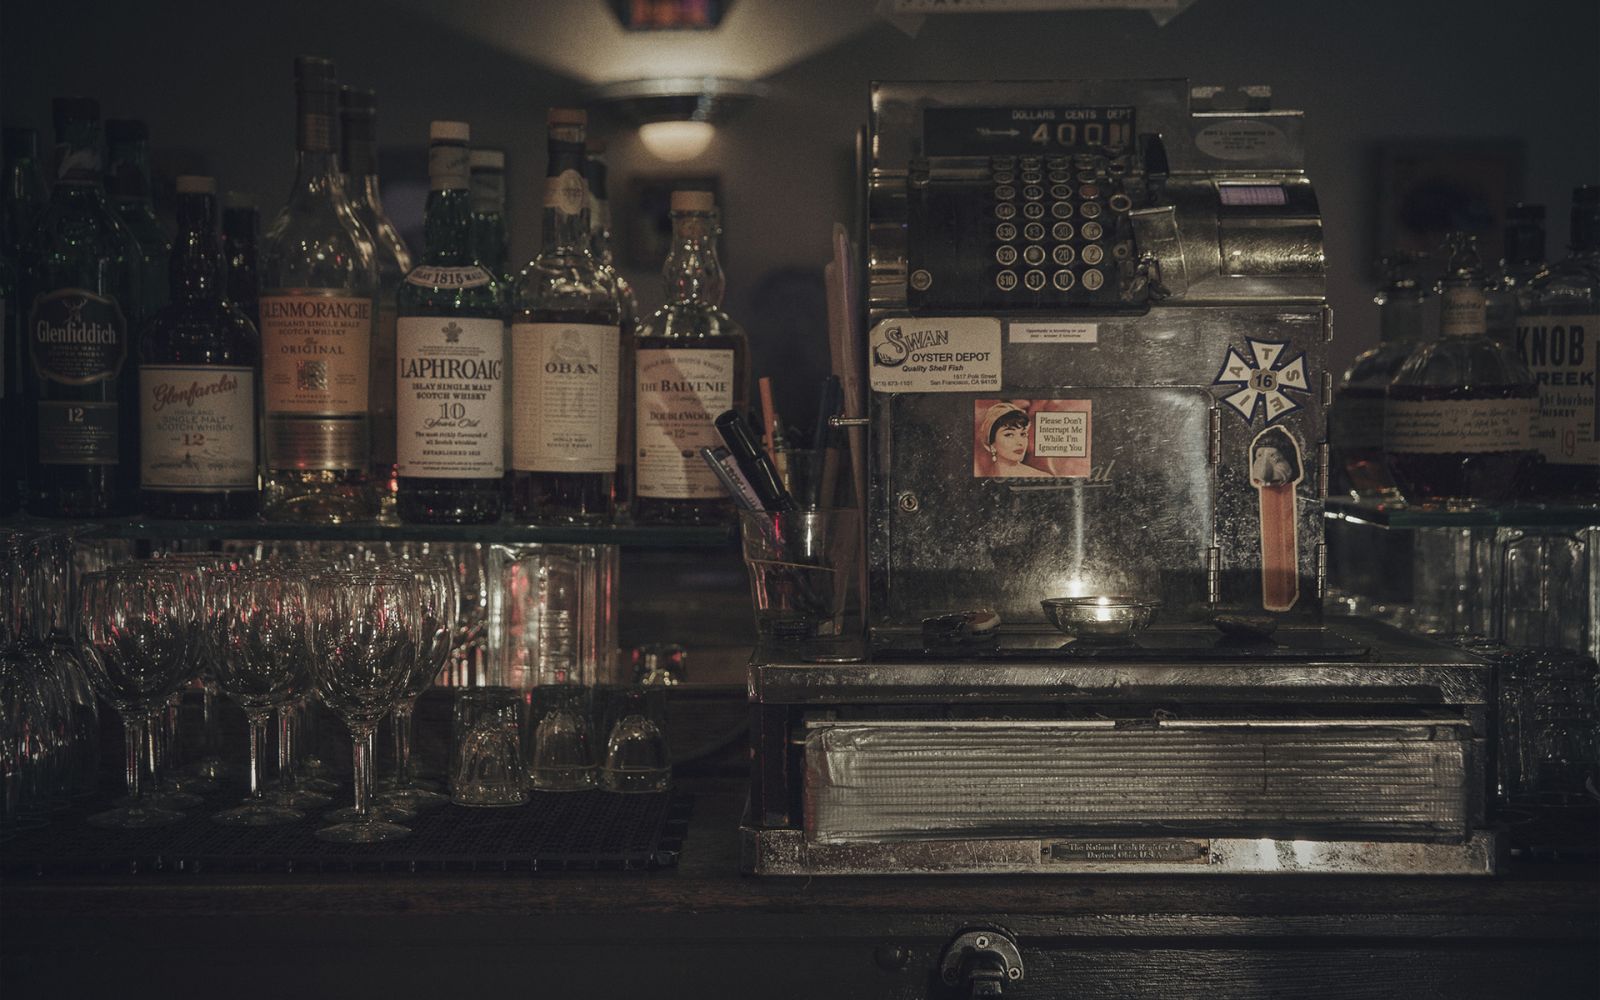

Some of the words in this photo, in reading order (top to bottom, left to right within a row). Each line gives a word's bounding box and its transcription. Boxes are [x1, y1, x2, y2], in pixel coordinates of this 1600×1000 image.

[1011, 110, 1056, 120] DOLLARS
[1064, 110, 1097, 120] CENTS
[1106, 109, 1132, 120] DEPT
[1058, 249, 1069, 260] 20
[433, 272, 464, 284] 1815
[999, 274, 1014, 285] $10
[1029, 274, 1040, 285] $1
[1058, 274, 1069, 285] 10
[307, 320, 338, 328] SINGLE
[37, 320, 116, 344] Glenfiddich
[279, 328, 310, 336] SCOTCH
[312, 328, 346, 336] WHISKY
[280, 345, 345, 355] ORIGINAL
[1516, 324, 1585, 368] KNOB
[912, 352, 953, 362] OYSTER
[955, 352, 991, 362] DEPOT
[400, 358, 502, 380] LAPHROAIG
[545, 362, 598, 374] OBAN
[902, 365, 928, 373] Quality
[640, 383, 657, 392] THE
[661, 380, 728, 392] BALVENIE
[1255, 374, 1273, 388] 16
[412, 382, 436, 390] ISLAY
[437, 383, 470, 391] SINGLE
[472, 384, 492, 392] MALT
[152, 374, 239, 412] Glenfarclas
[416, 392, 450, 400] SCOTCH
[453, 392, 487, 400] WHISKY
[68, 408, 84, 422] 12
[439, 402, 466, 420] 10
[1040, 416, 1062, 424] Please
[1064, 416, 1082, 424] Don't
[197, 424, 235, 432] WHISKY
[1039, 426, 1070, 434] Interrupt
[182, 433, 205, 446] 12
[1038, 444, 1068, 452] Ignoring
[1070, 444, 1082, 452] You
